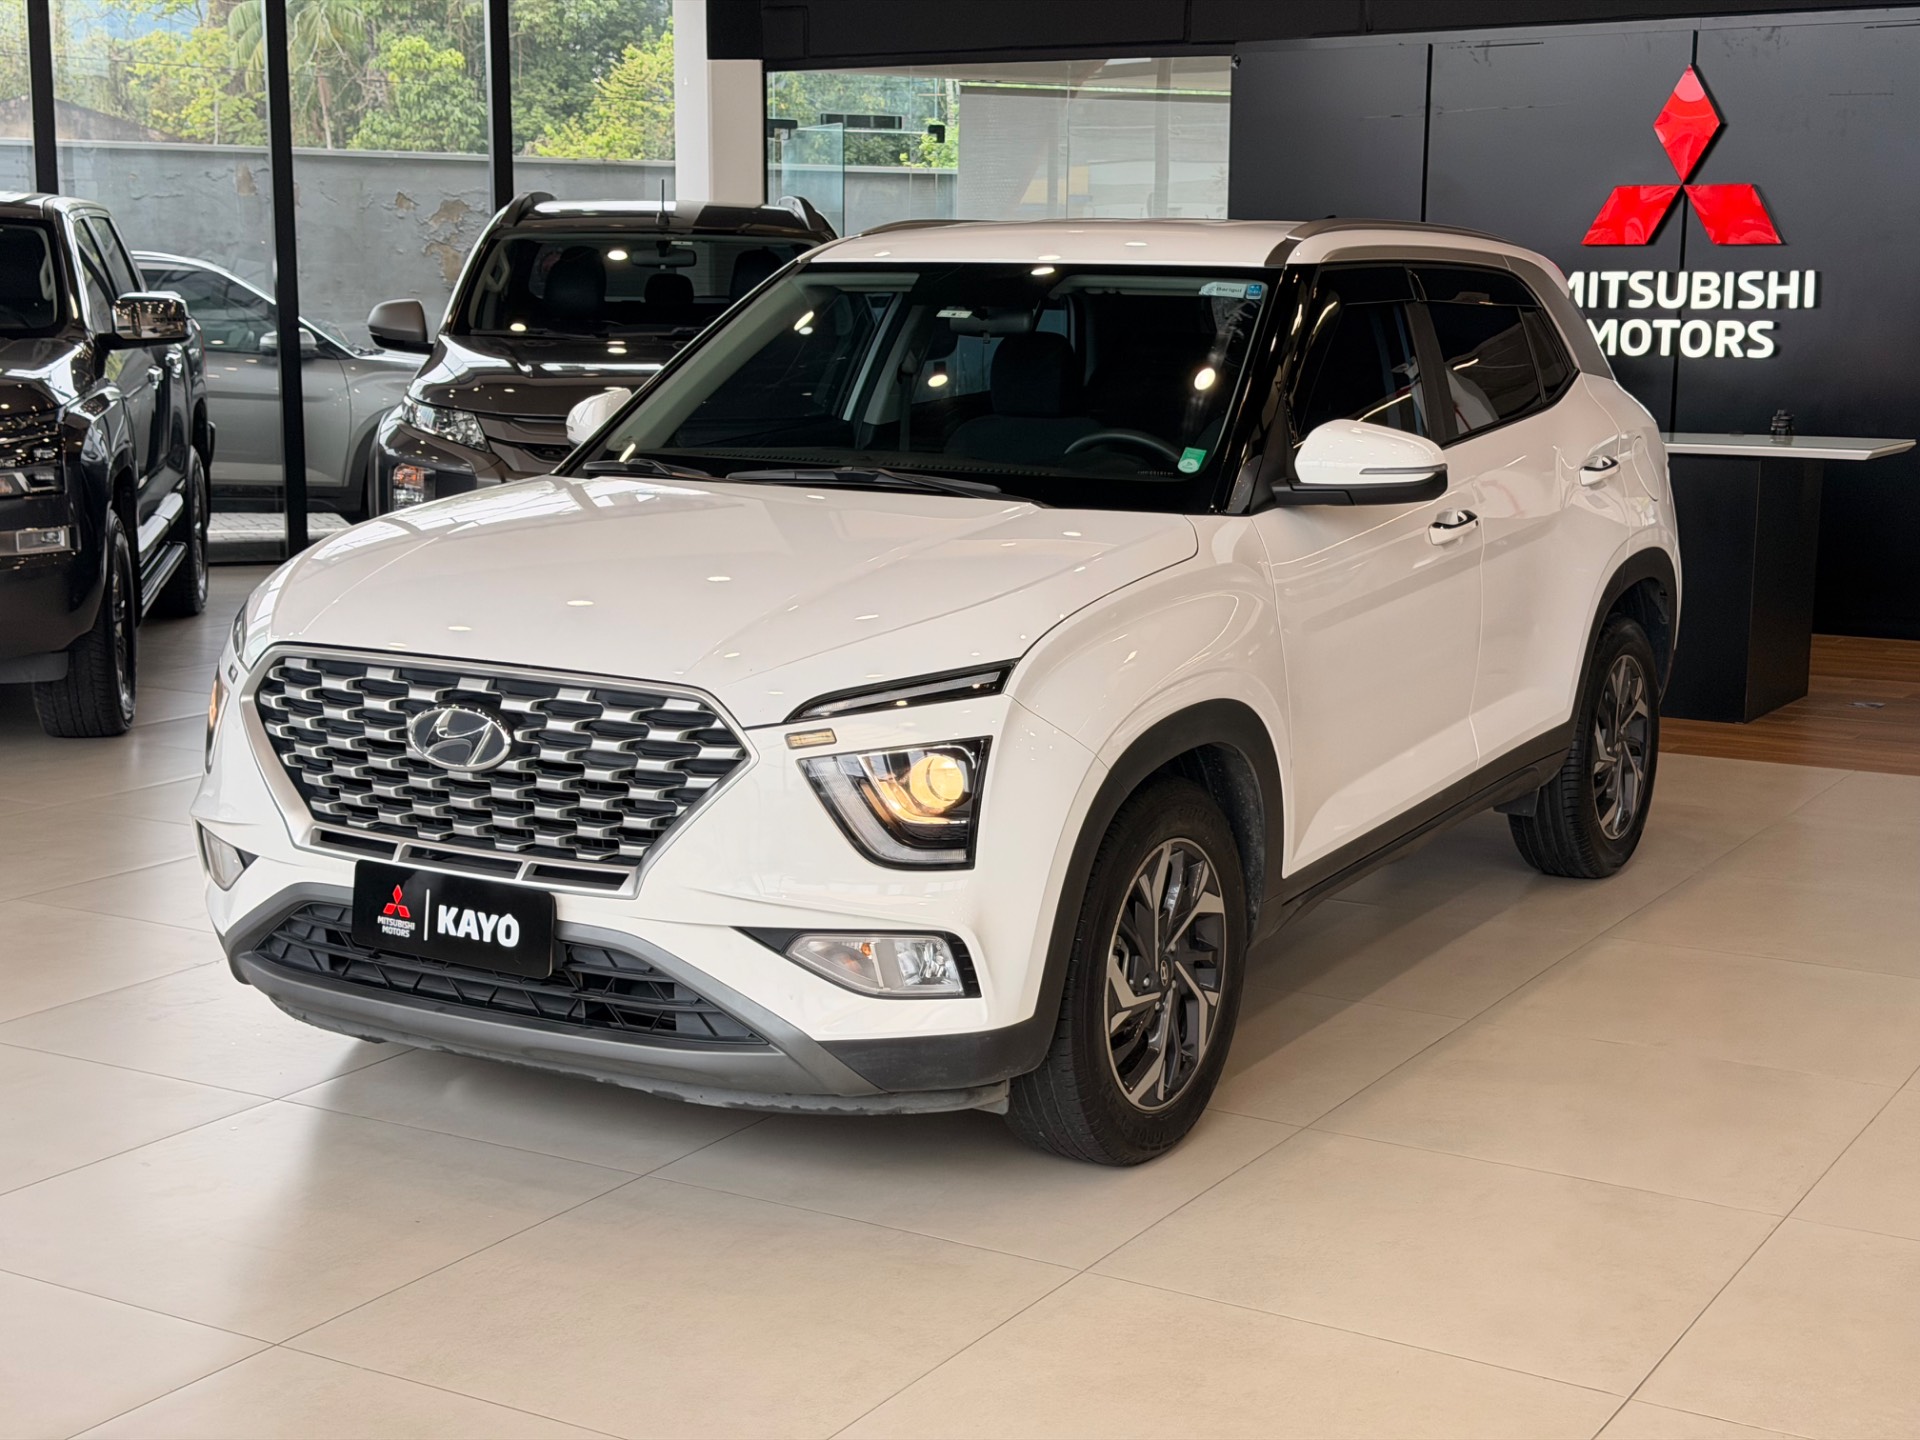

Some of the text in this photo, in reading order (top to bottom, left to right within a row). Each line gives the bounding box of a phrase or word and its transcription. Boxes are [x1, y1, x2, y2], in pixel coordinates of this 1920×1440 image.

[1586, 318, 1775, 359] MOTORS
[377, 915, 416, 931] MITSUBISHI
[381, 924, 411, 938] MOTORS
